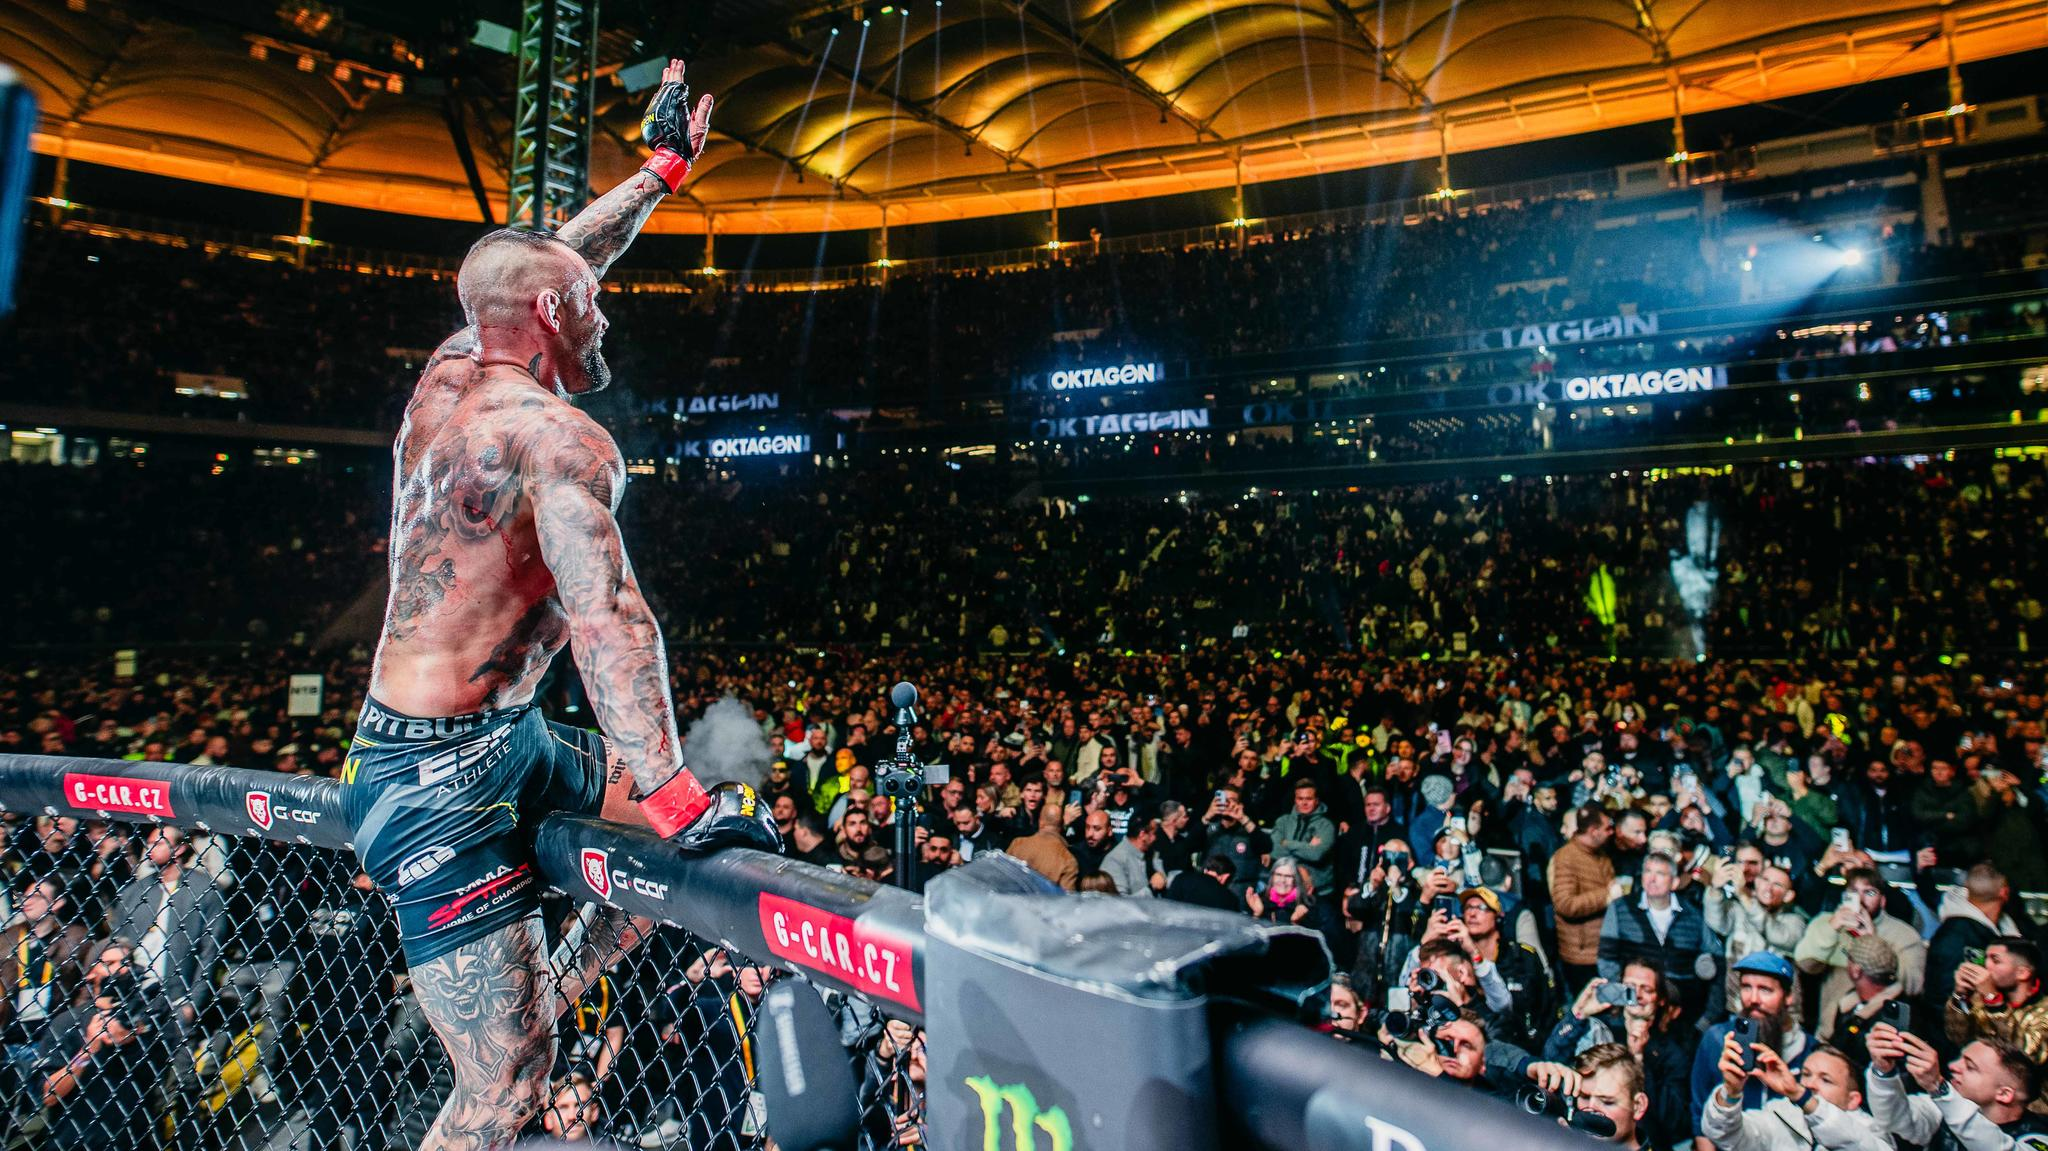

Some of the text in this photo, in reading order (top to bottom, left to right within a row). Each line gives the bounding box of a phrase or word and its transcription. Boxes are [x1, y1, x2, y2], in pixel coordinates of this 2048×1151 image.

[1051, 362, 1156, 390] OKTAGON
[1566, 366, 1713, 401] OKTAGON
[711, 435, 801, 457] OKTAGON
[436, 739, 513, 799] ATHLETE
[74, 781, 165, 811] G-CAR.CZ
[475, 902, 490, 914] OF
[772, 911, 900, 993] G-CAR.CZ
